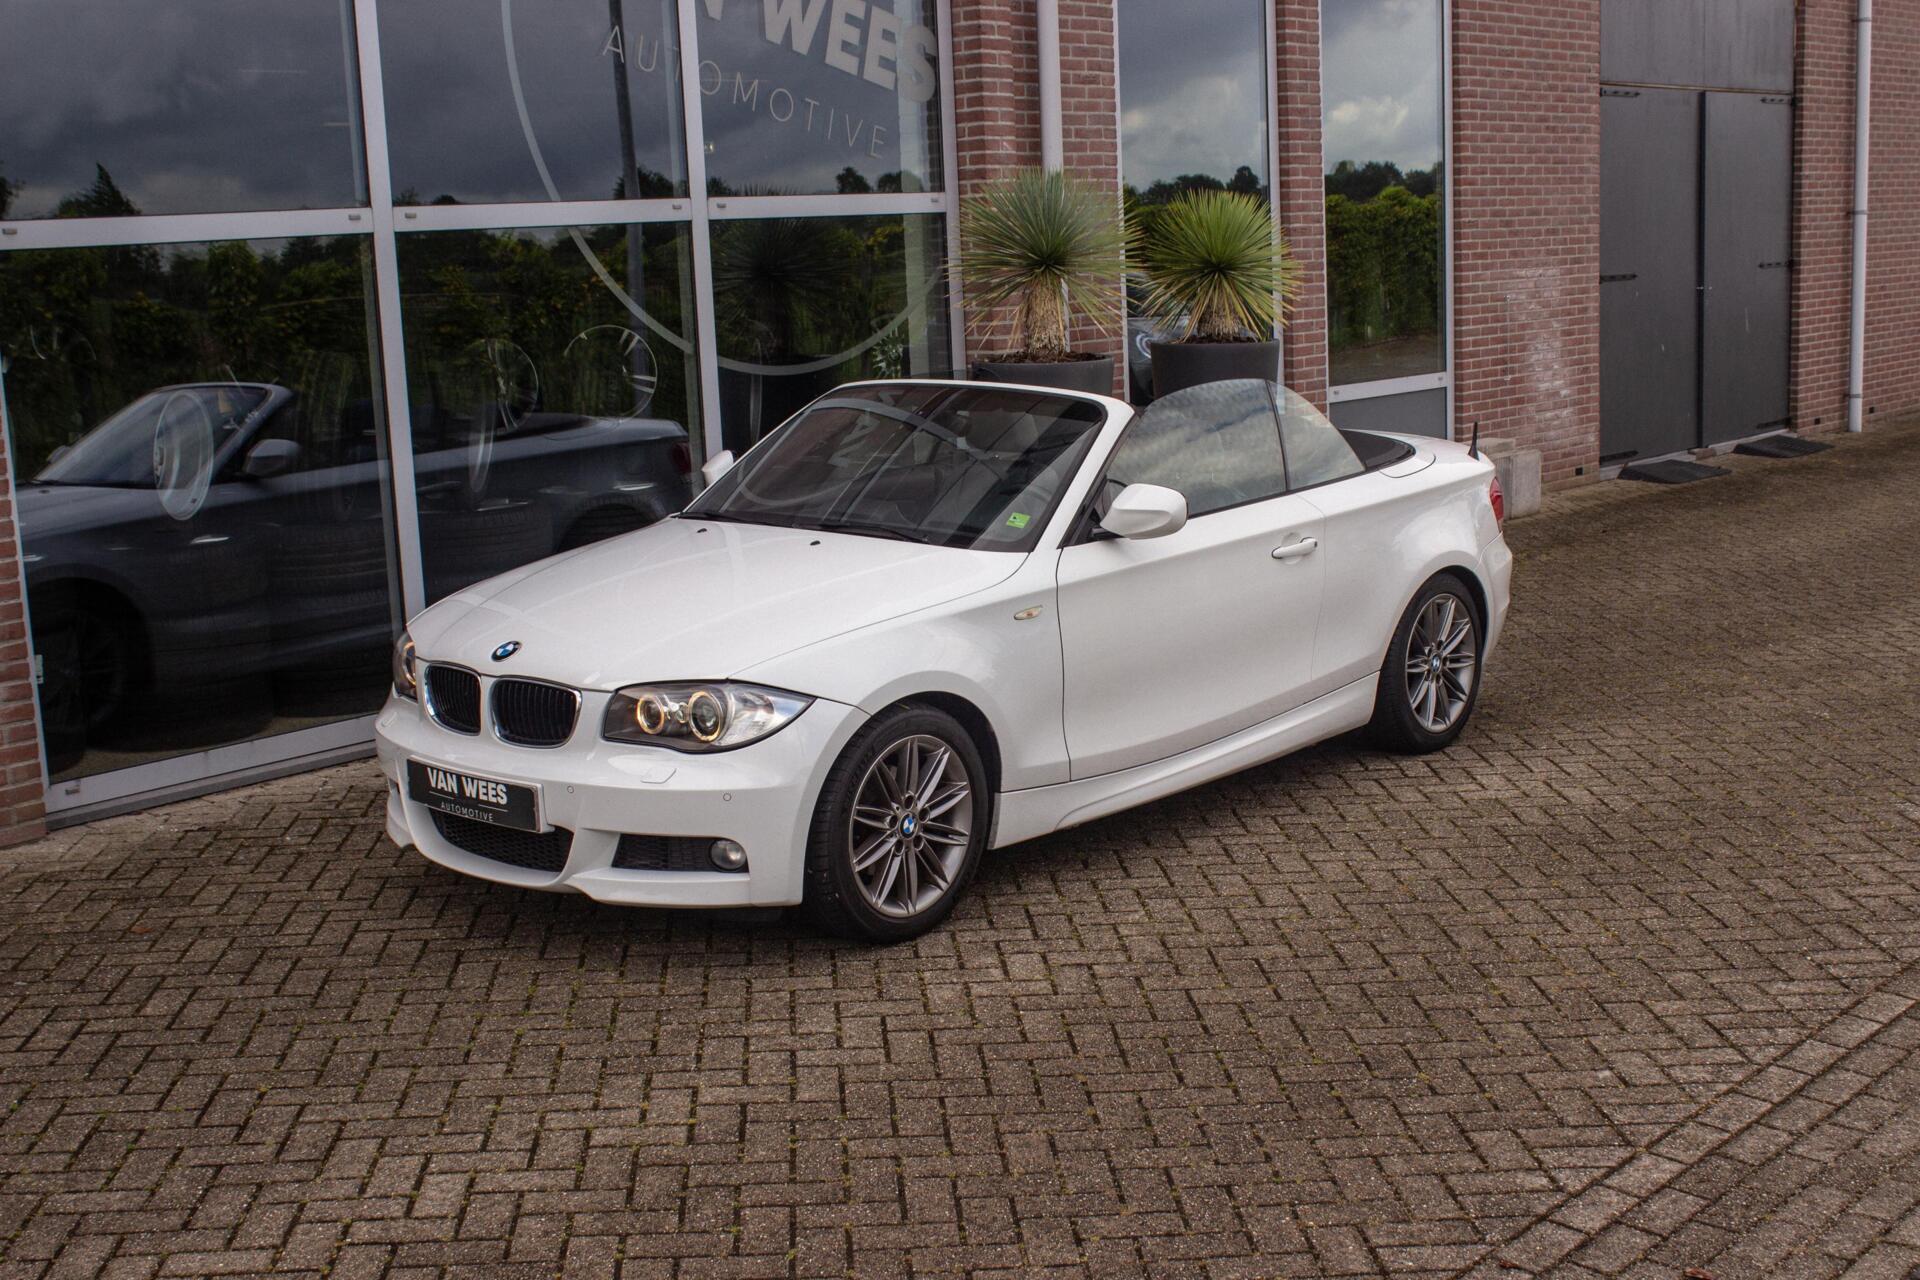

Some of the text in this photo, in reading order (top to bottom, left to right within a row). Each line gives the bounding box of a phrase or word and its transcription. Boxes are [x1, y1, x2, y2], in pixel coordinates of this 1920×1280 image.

[763, 0, 937, 102] WEES
[602, 25, 887, 159] AUTOMOTIVE
[427, 767, 507, 804] VAN WEES
[441, 802, 493, 822] AUTOMOTIVE
